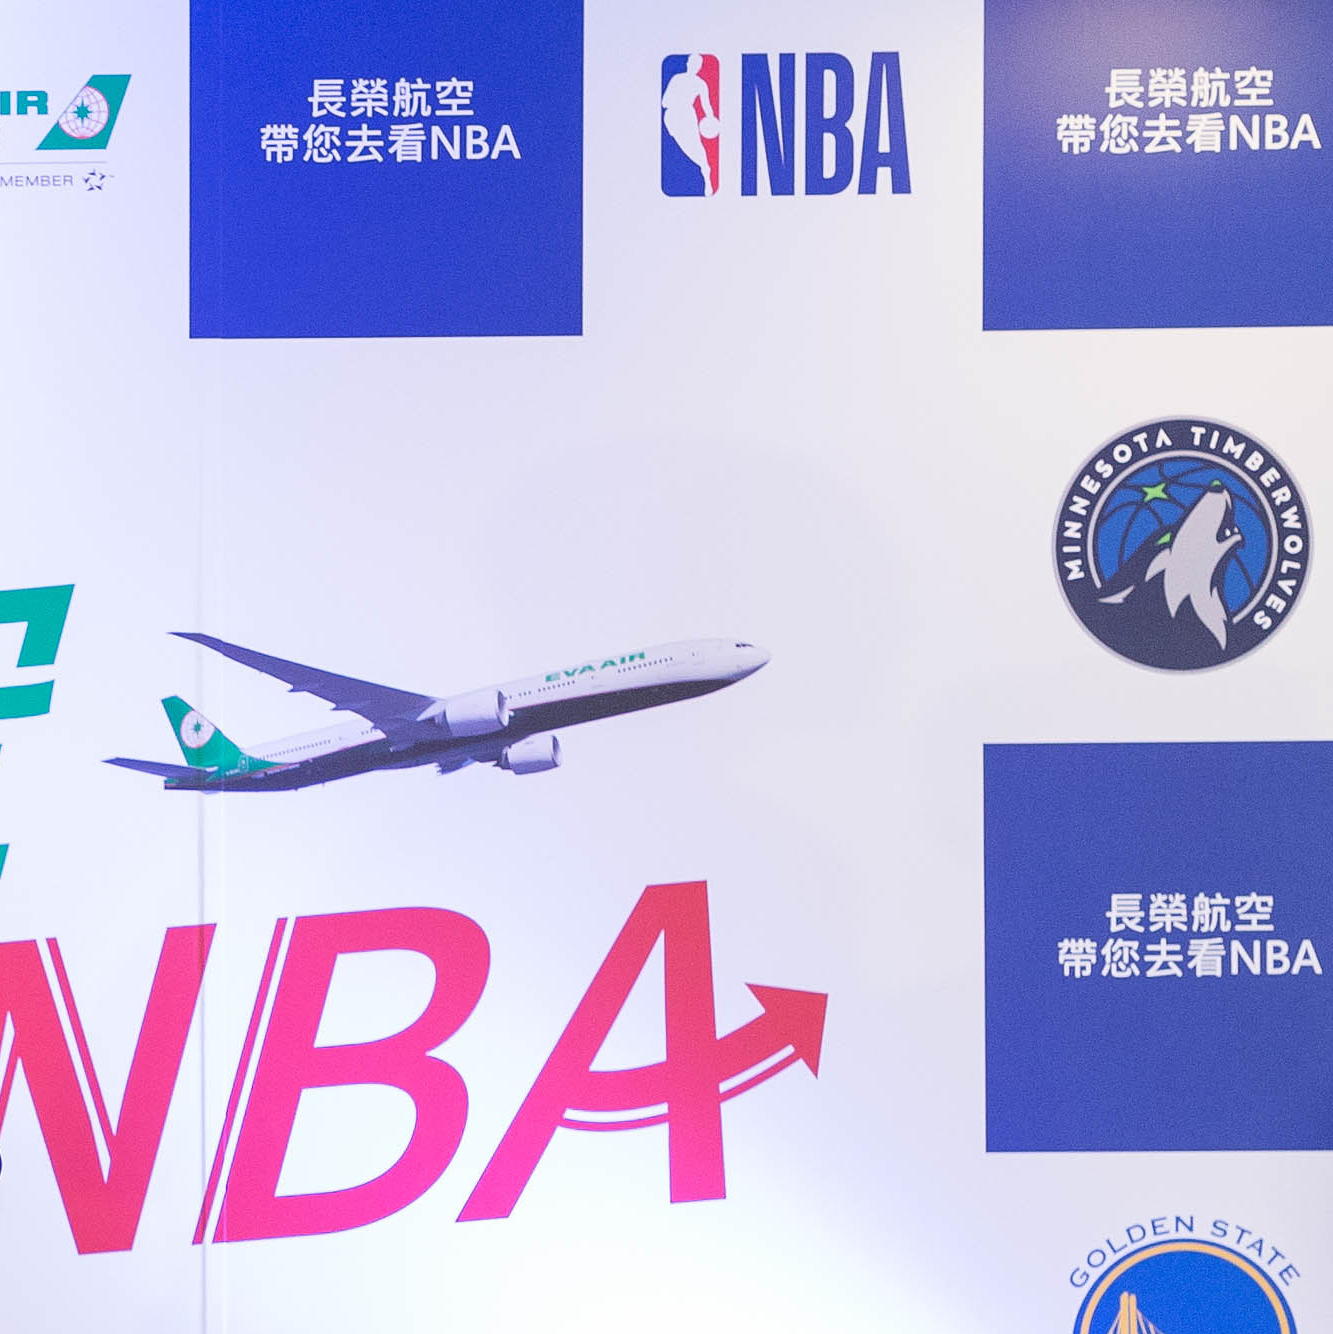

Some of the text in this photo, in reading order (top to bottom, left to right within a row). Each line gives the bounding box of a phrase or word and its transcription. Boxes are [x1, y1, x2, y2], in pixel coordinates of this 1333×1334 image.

[307, 76, 474, 118] 長榮航空
[1104, 66, 1274, 109] 長榮航空
[260, 122, 522, 164] 帶您去看NBA
[741, 50, 912, 197] NBA
[1056, 112, 1322, 155] 帶您去看NBA
[0, 175, 74, 187] MEMBER
[1062, 425, 1304, 629] MINNESOTA TIMBERWOLVES
[544, 650, 647, 683] EVA AIR
[1105, 892, 1275, 933] 長榮航空
[1057, 937, 1323, 979] 帶您去看NBA
[1069, 1215, 1302, 1289] GOLDEN STATE
